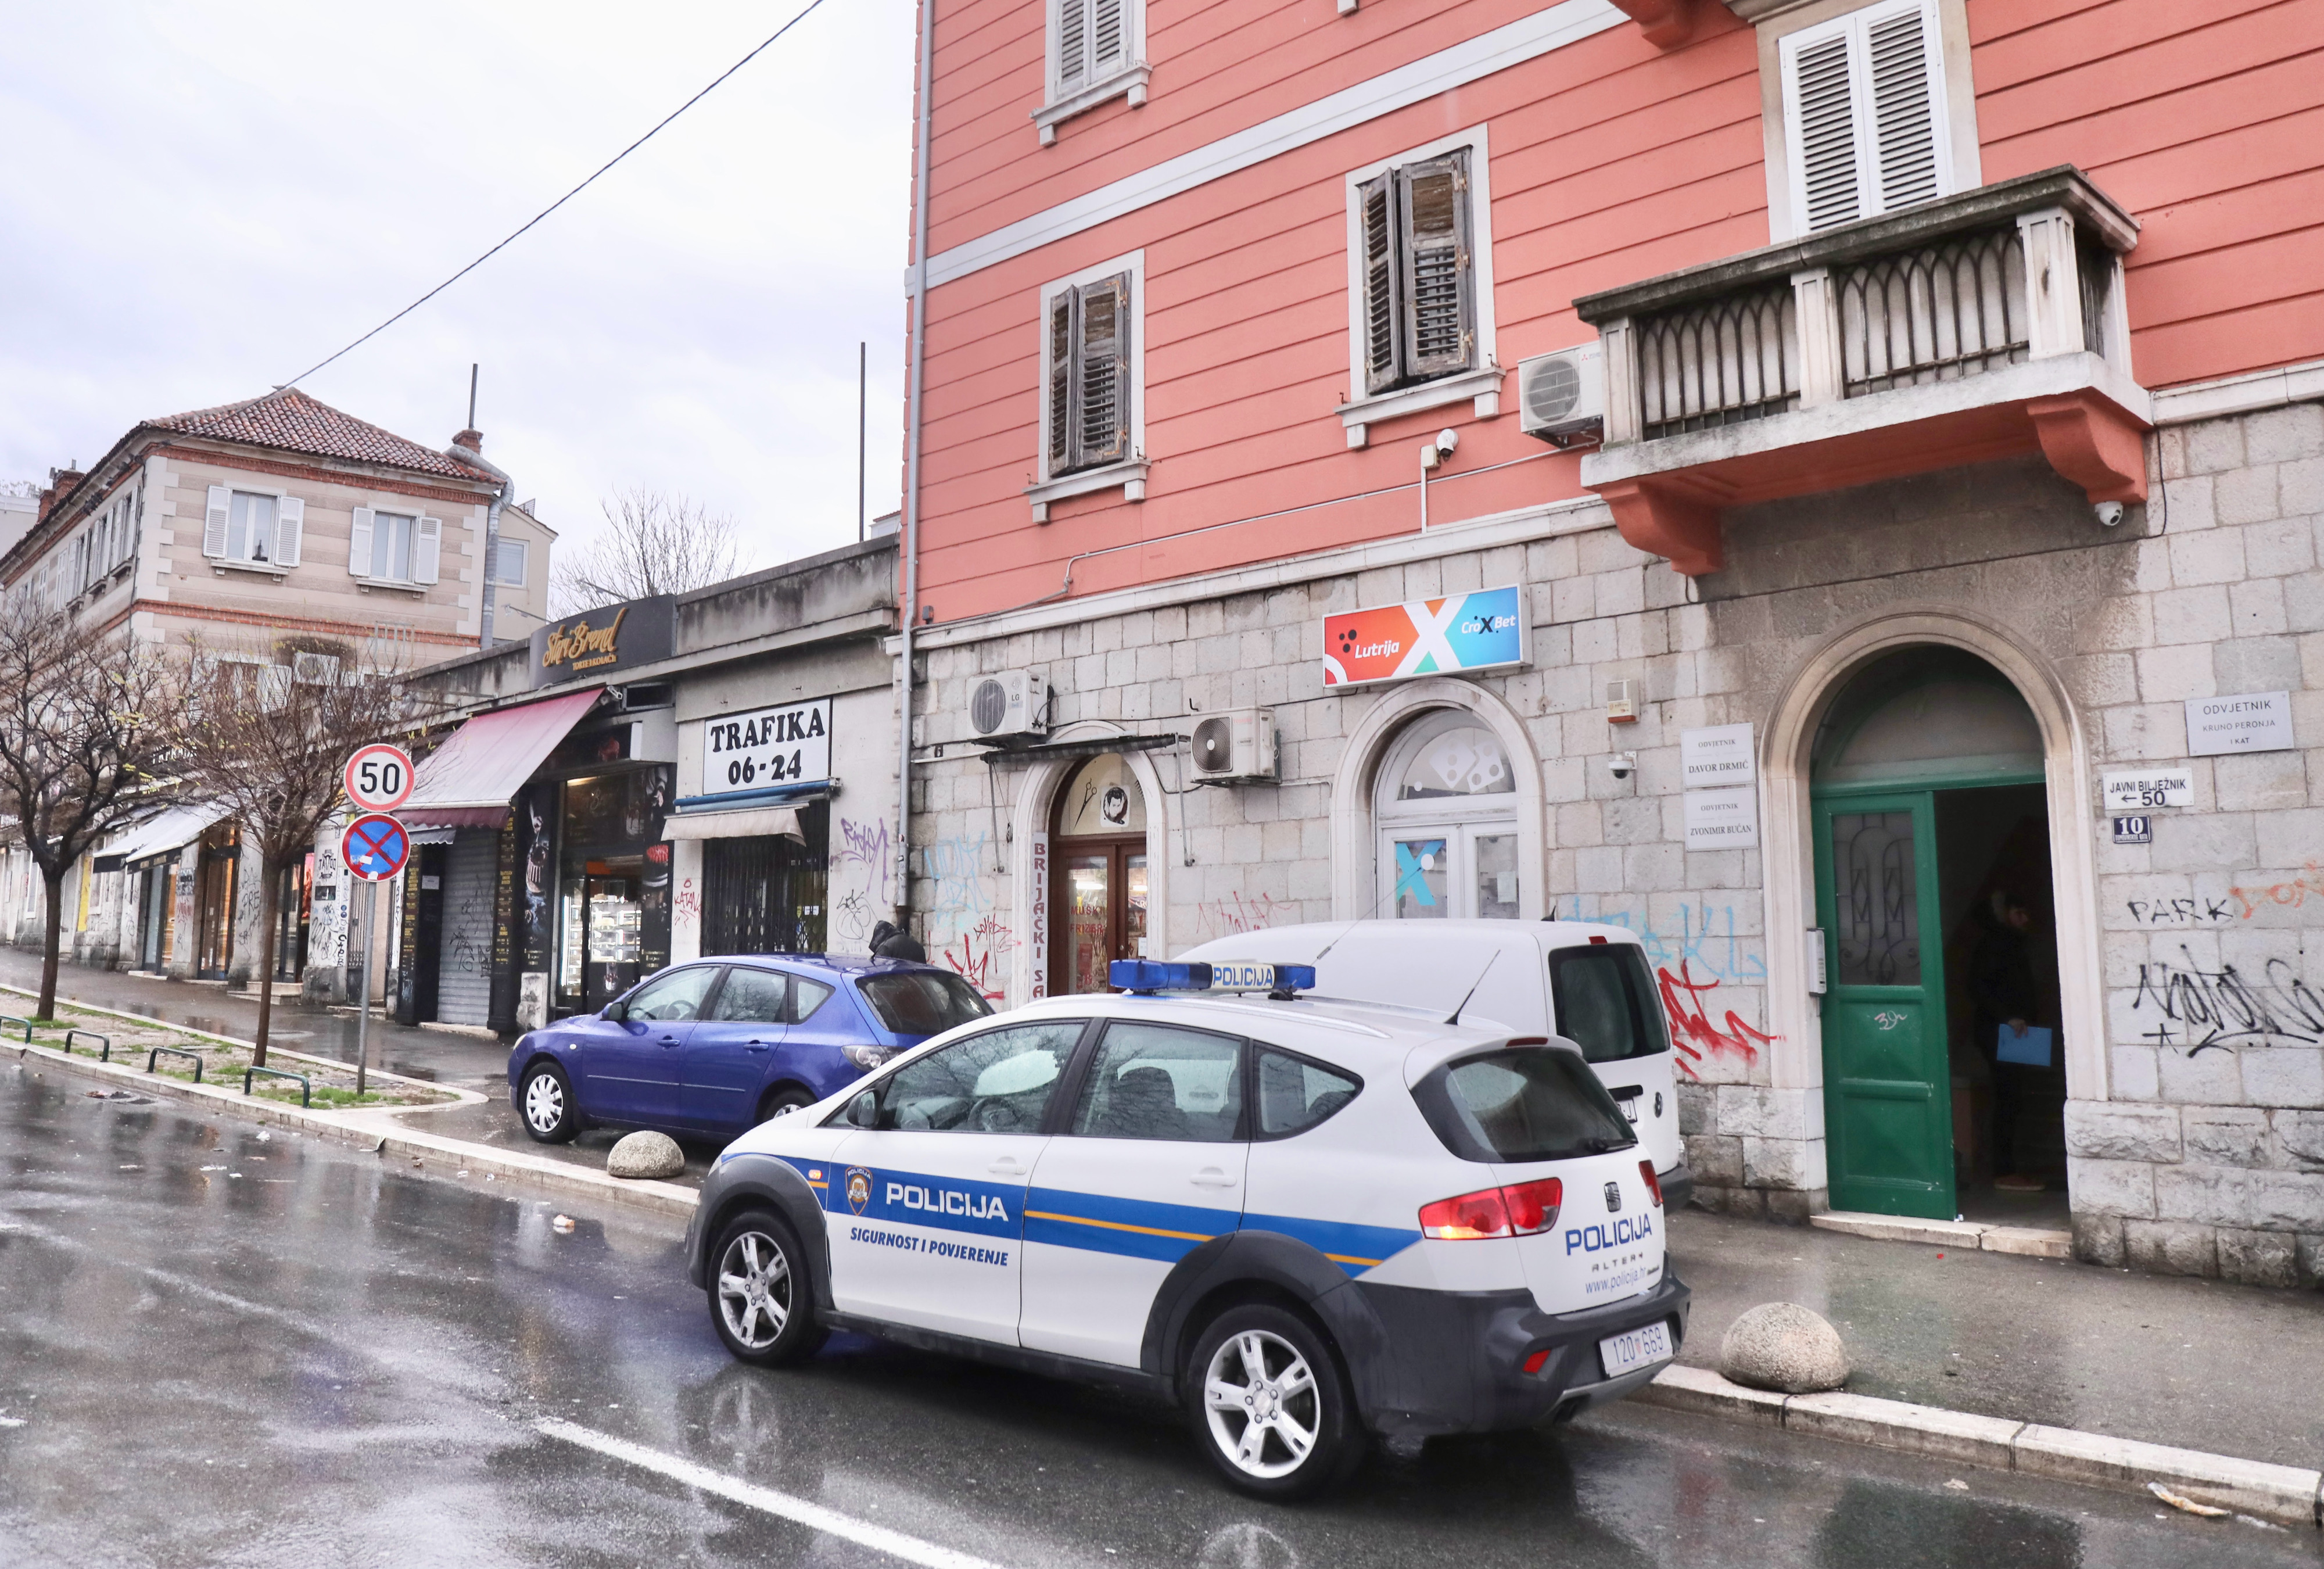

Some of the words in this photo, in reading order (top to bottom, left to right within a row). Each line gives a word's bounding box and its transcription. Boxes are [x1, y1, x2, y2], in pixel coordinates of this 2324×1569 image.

[568, 607, 627, 659] Brend
[1354, 640, 1400, 659] Lutrija
[2203, 700, 2272, 715] ODVJETNIK
[711, 708, 825, 753] TRAFIKA
[2203, 723, 2233, 732] KRUNO
[2235, 720, 2275, 729] PERONJA
[1698, 739, 1735, 748] ODVJETNIK
[1688, 764, 1717, 773] DAVOR
[1720, 759, 1748, 771] DRMIĆ
[360, 762, 400, 794] 50
[2110, 782, 2136, 793] JAVNI
[2138, 777, 2186, 791] BILJEŽNIK
[1701, 803, 1738, 811] ODVJETNIK
[2142, 790, 2165, 807] 50
[1690, 826, 1726, 836] ZVONIMIR
[1727, 823, 1752, 833] BUĆAN
[2119, 817, 2143, 834] 10
[1033, 843, 1046, 959] BRIJAČKI
[1071, 904, 1102, 915] MUŠKI
[2127, 898, 2233, 924] PARK
[1213, 967, 1273, 986] POLICIJA
[848, 1168, 871, 1180] POLICIJA
[886, 1182, 1009, 1221] POLICIJA
[1565, 1213, 1652, 1256] POLICIJA
[851, 1227, 919, 1251] SIGURNOST
[921, 1239, 926, 1252] I
[929, 1240, 1009, 1266] POVJERENJE
[1585, 1266, 1646, 1294] www.policija.hr
[1613, 1336, 1636, 1364] 120
[1641, 1327, 1663, 1355] 669
